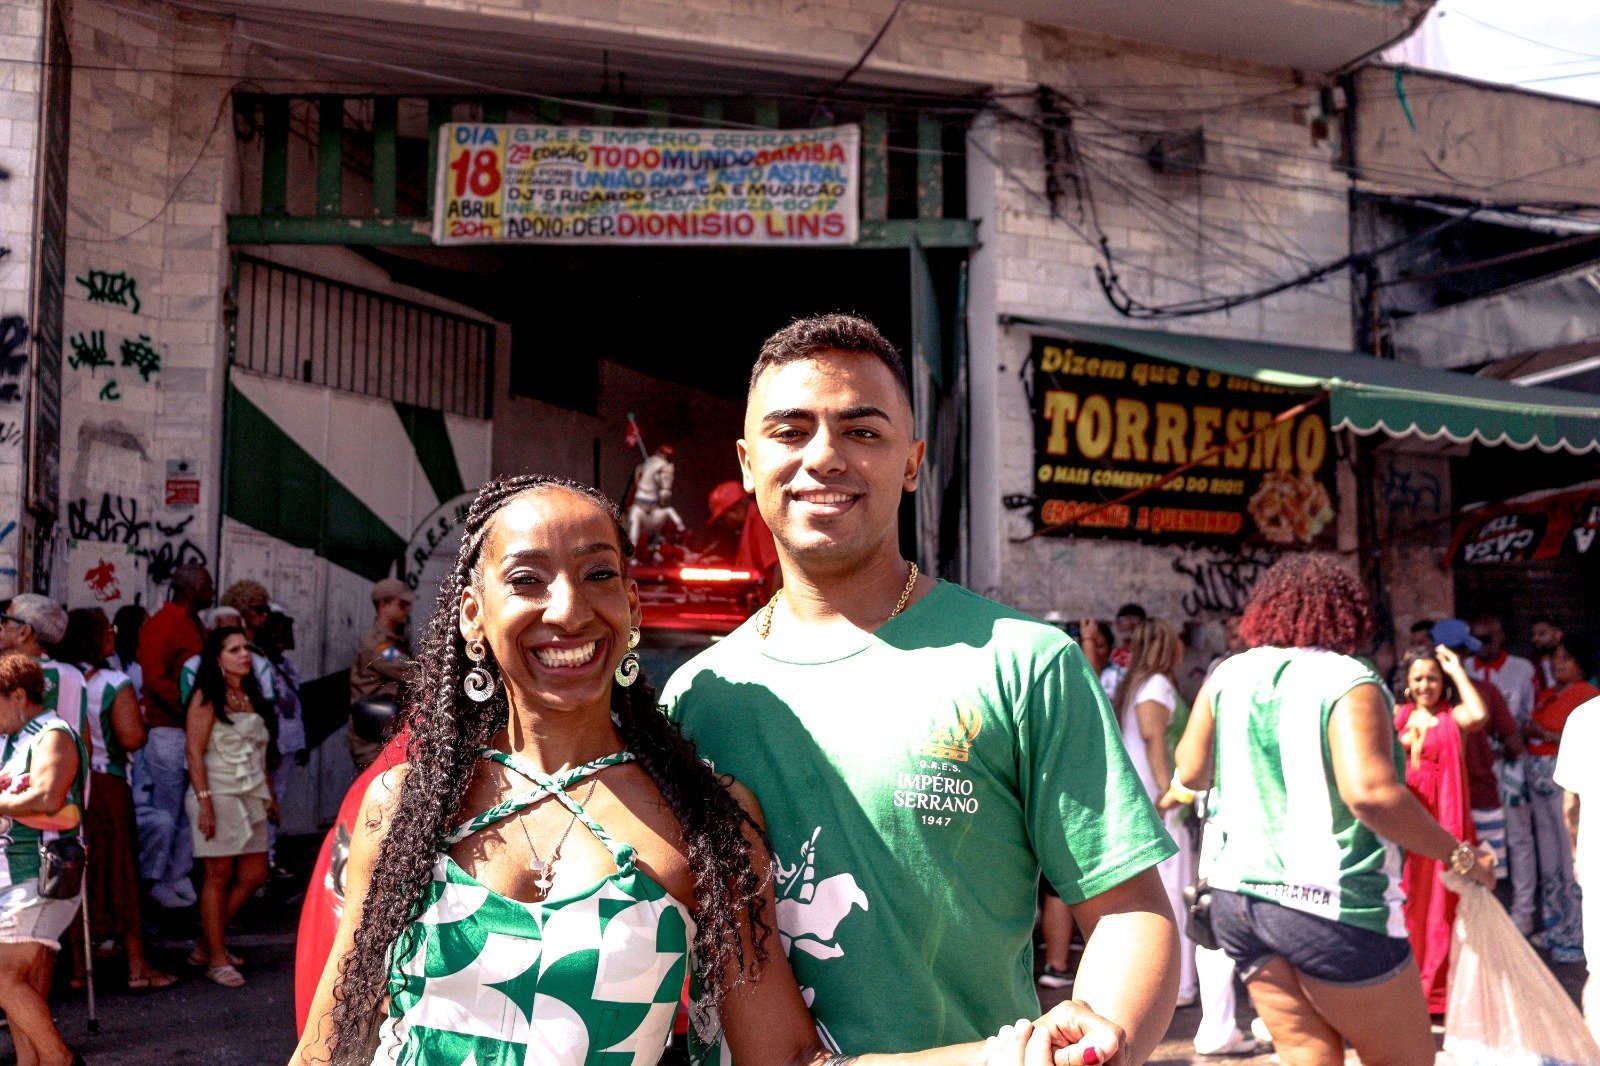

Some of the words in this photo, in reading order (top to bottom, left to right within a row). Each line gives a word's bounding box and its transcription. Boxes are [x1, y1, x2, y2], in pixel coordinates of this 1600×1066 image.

[455, 126, 498, 145] DIA
[590, 145, 661, 170] TODO
[662, 149, 755, 171] MUNDO
[754, 143, 845, 167] SAMBA
[450, 148, 501, 198] 18
[575, 168, 646, 189] UNIÃO
[716, 167, 764, 185] ALTO
[767, 163, 848, 185] ASTRAL
[560, 187, 645, 202] RICARDO
[447, 201, 500, 219] ABRIL
[449, 220, 494, 238] 20h
[573, 215, 616, 237] DEP.
[616, 212, 755, 237] DIONISIO
[765, 212, 846, 238] LINS
[1040, 346, 1128, 381] Dizem
[1131, 362, 1180, 387] que
[1043, 389, 1328, 474] TORRESMO
[1037, 463, 1053, 483] O
[1053, 465, 1091, 485] MAIS
[1185, 475, 1208, 494] DO
[918, 760, 961, 773] G.R.E.S.
[897, 772, 973, 796] IMPÉRIO
[893, 789, 979, 814] SERRANO
[921, 815, 952, 827] 1947
